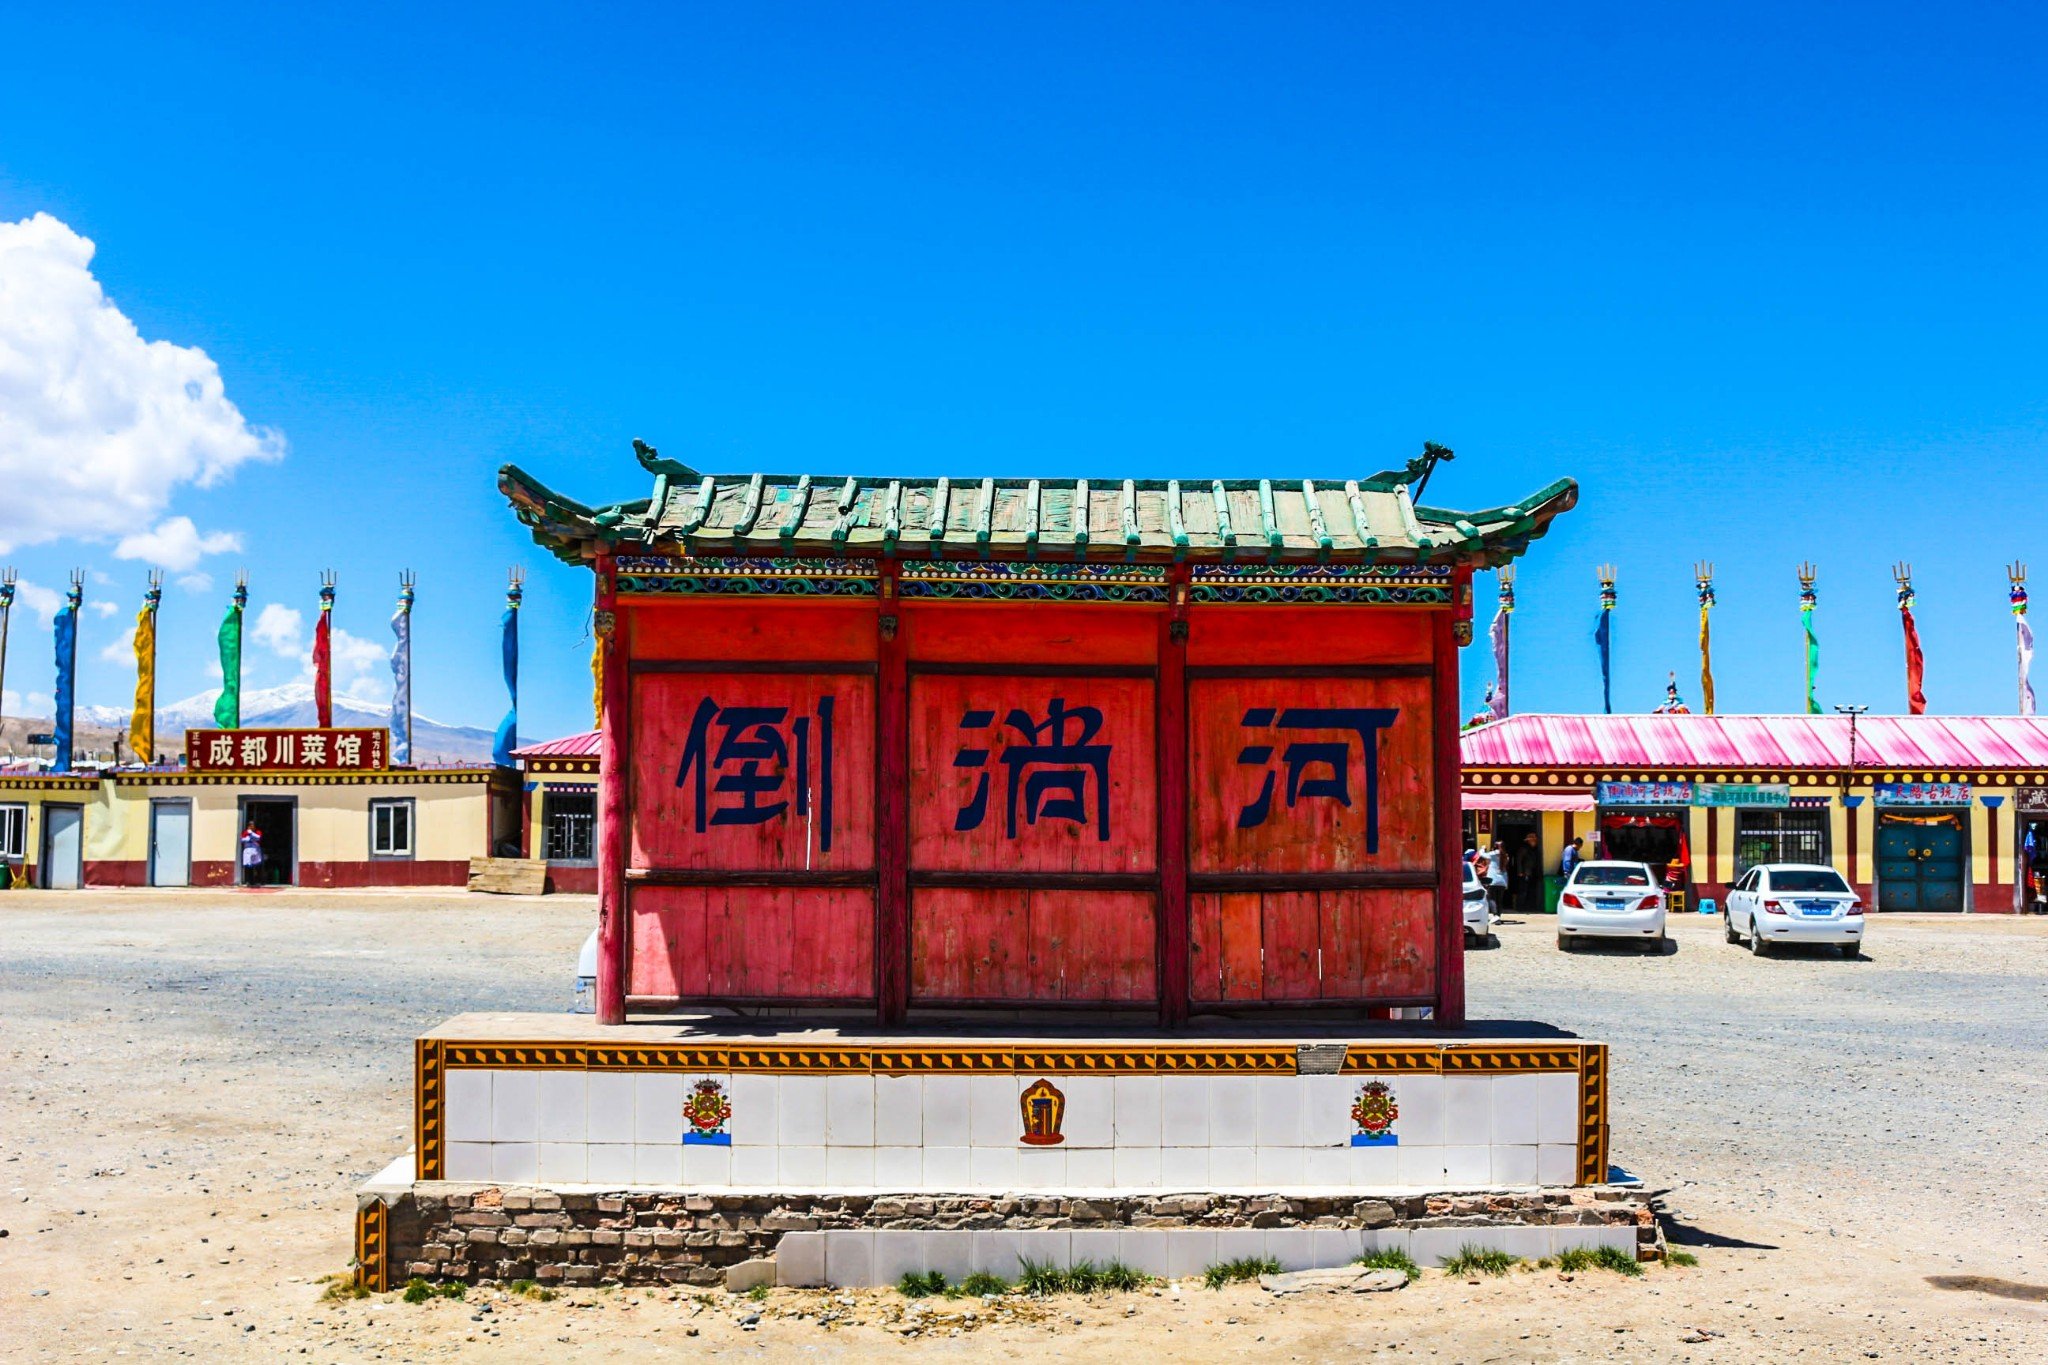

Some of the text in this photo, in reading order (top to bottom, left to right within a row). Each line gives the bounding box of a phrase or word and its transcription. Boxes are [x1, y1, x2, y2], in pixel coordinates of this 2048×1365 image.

[208, 734, 362, 767] 成都川菜馆
[675, 695, 1401, 853] 倒淌河
